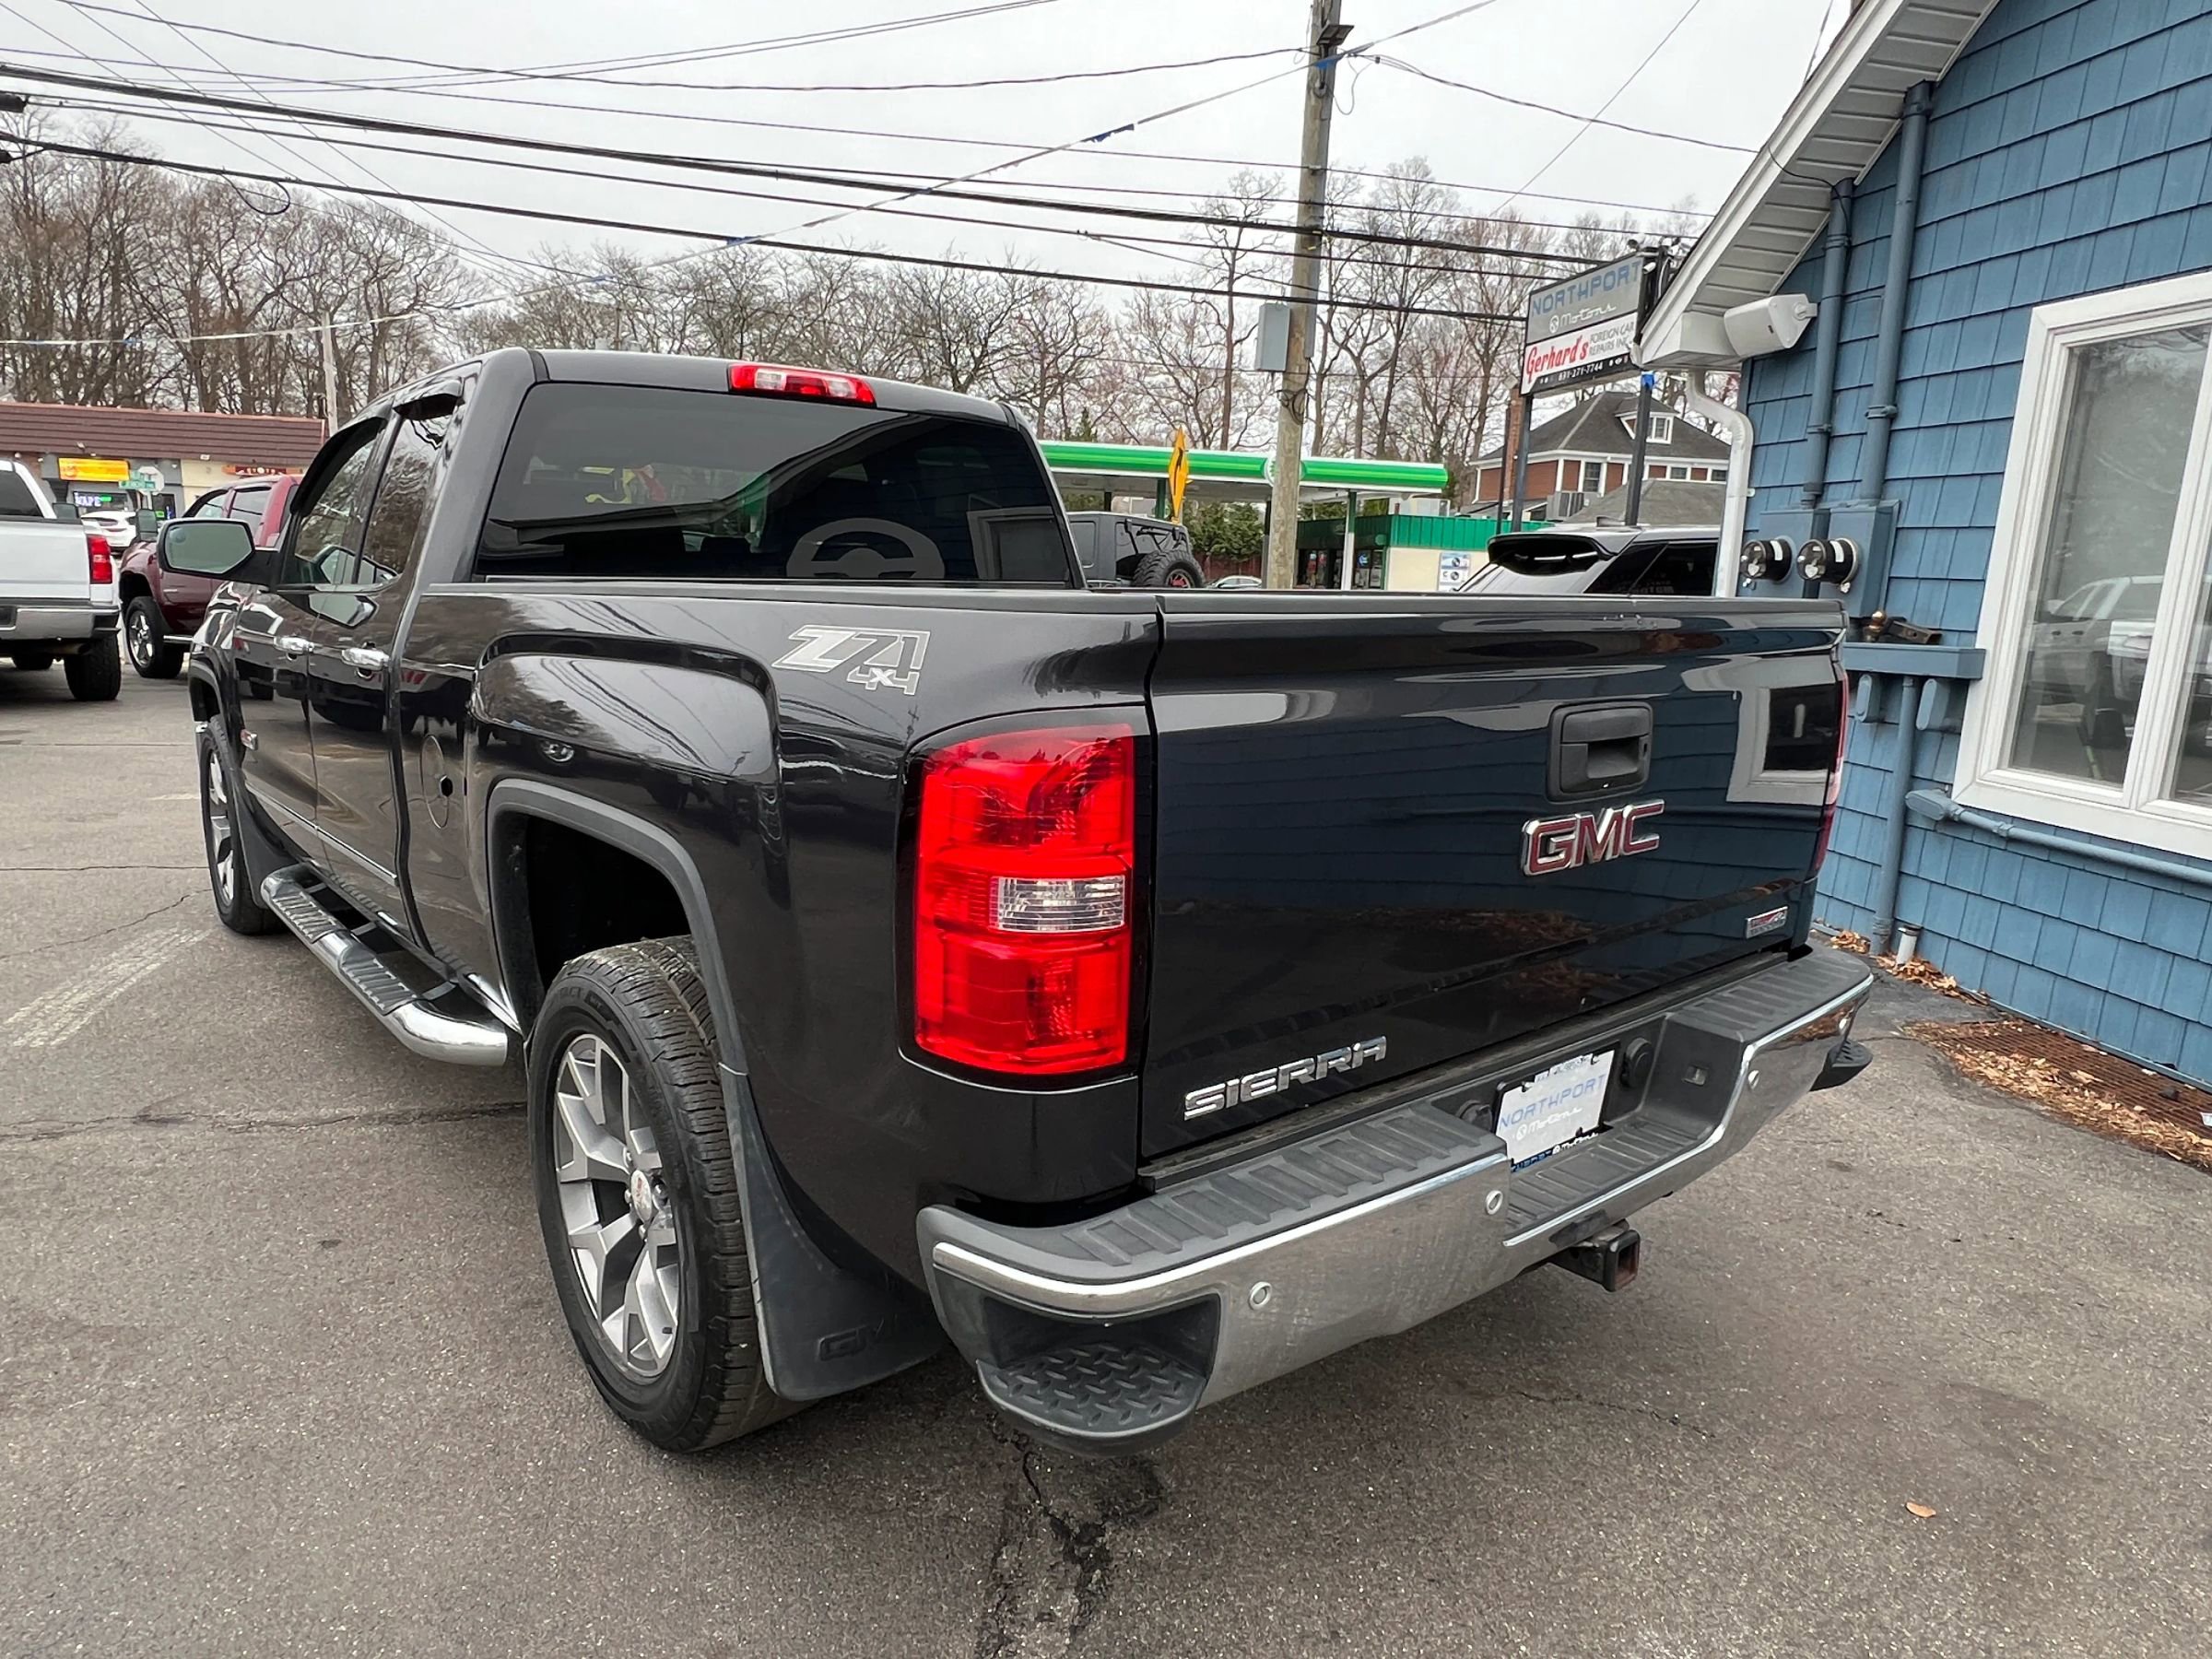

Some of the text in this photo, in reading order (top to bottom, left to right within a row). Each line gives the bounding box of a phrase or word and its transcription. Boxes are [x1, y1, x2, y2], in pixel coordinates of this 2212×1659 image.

[1532, 261, 1641, 317] NORTHPORT
[1525, 335, 1590, 384] Gerhard's
[771, 624, 931, 673] Z71
[1522, 798, 1665, 877] GMC
[1183, 1035, 1387, 1122] SIERRA
[1499, 1073, 1606, 1130] NORTHPORT
